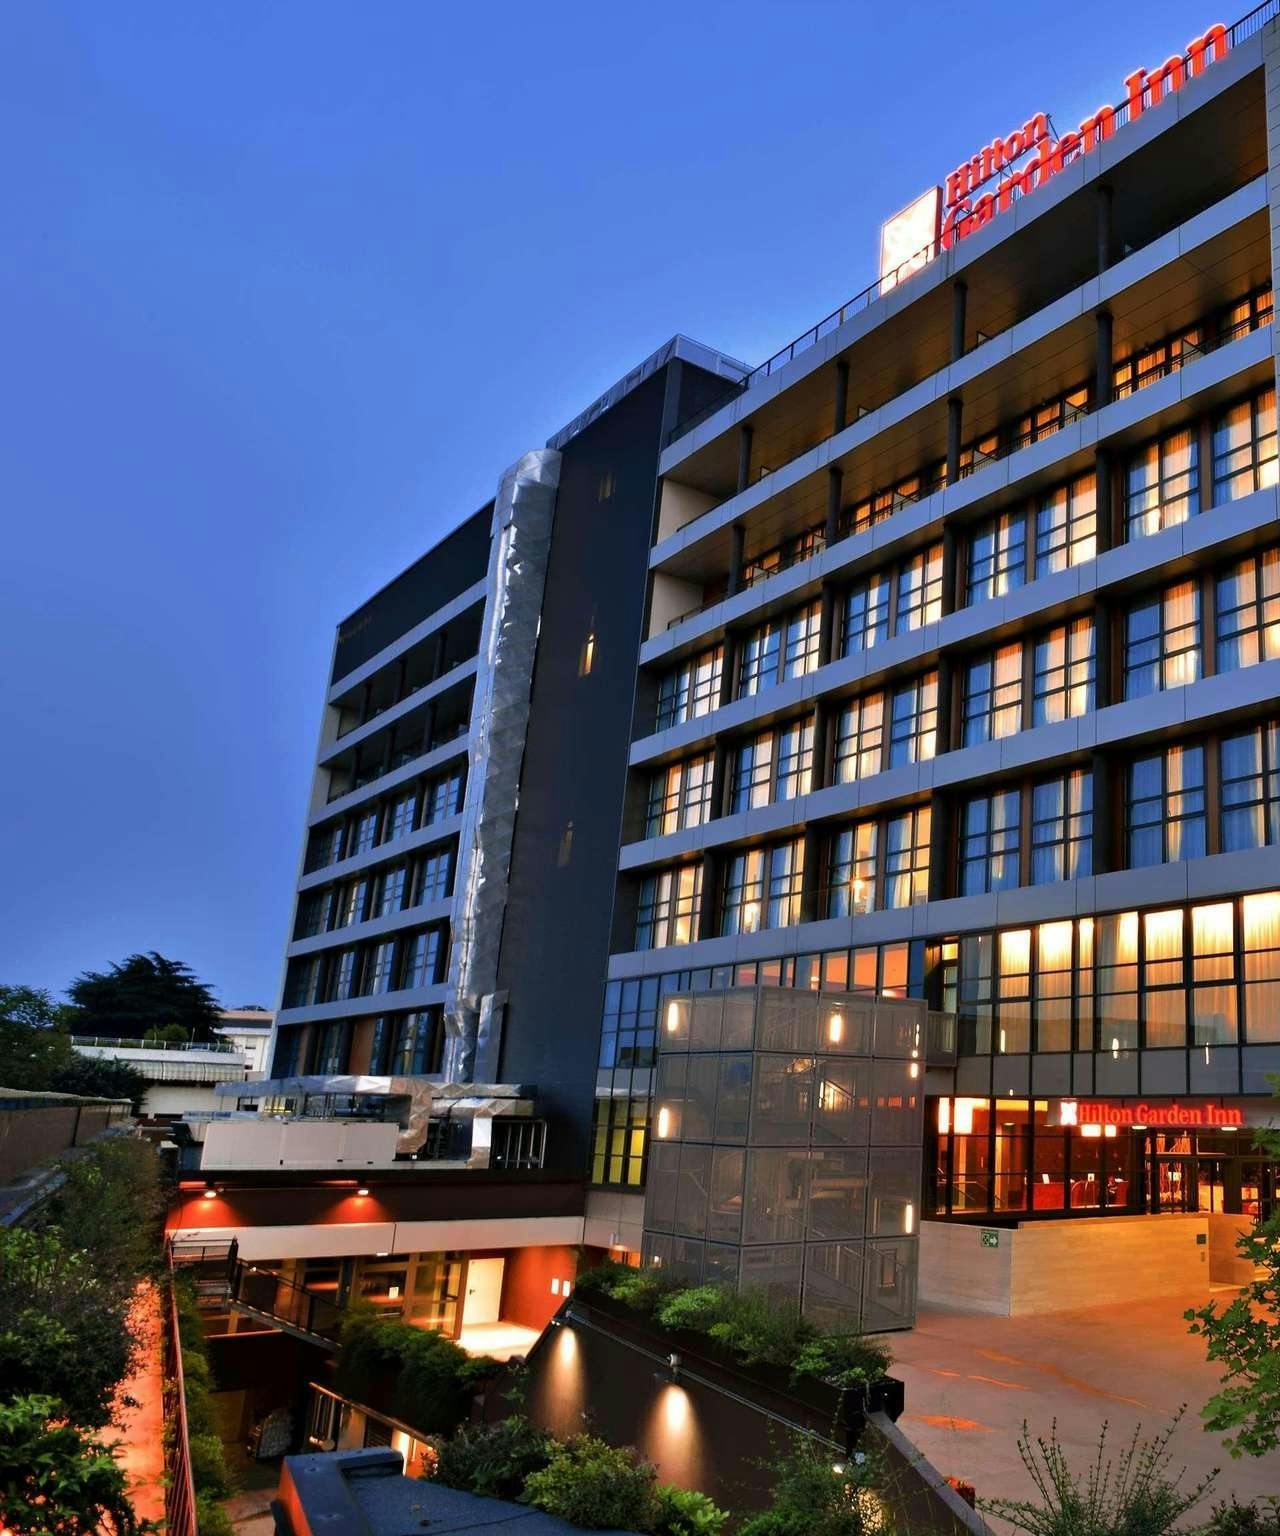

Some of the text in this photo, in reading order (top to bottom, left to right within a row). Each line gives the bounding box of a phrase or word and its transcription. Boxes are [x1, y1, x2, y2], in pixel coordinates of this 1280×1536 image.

[941, 23, 1227, 250] Garden Inn
[945, 112, 1049, 208] Hilton
[1079, 1103, 1242, 1125] Hilton Garden Inn
